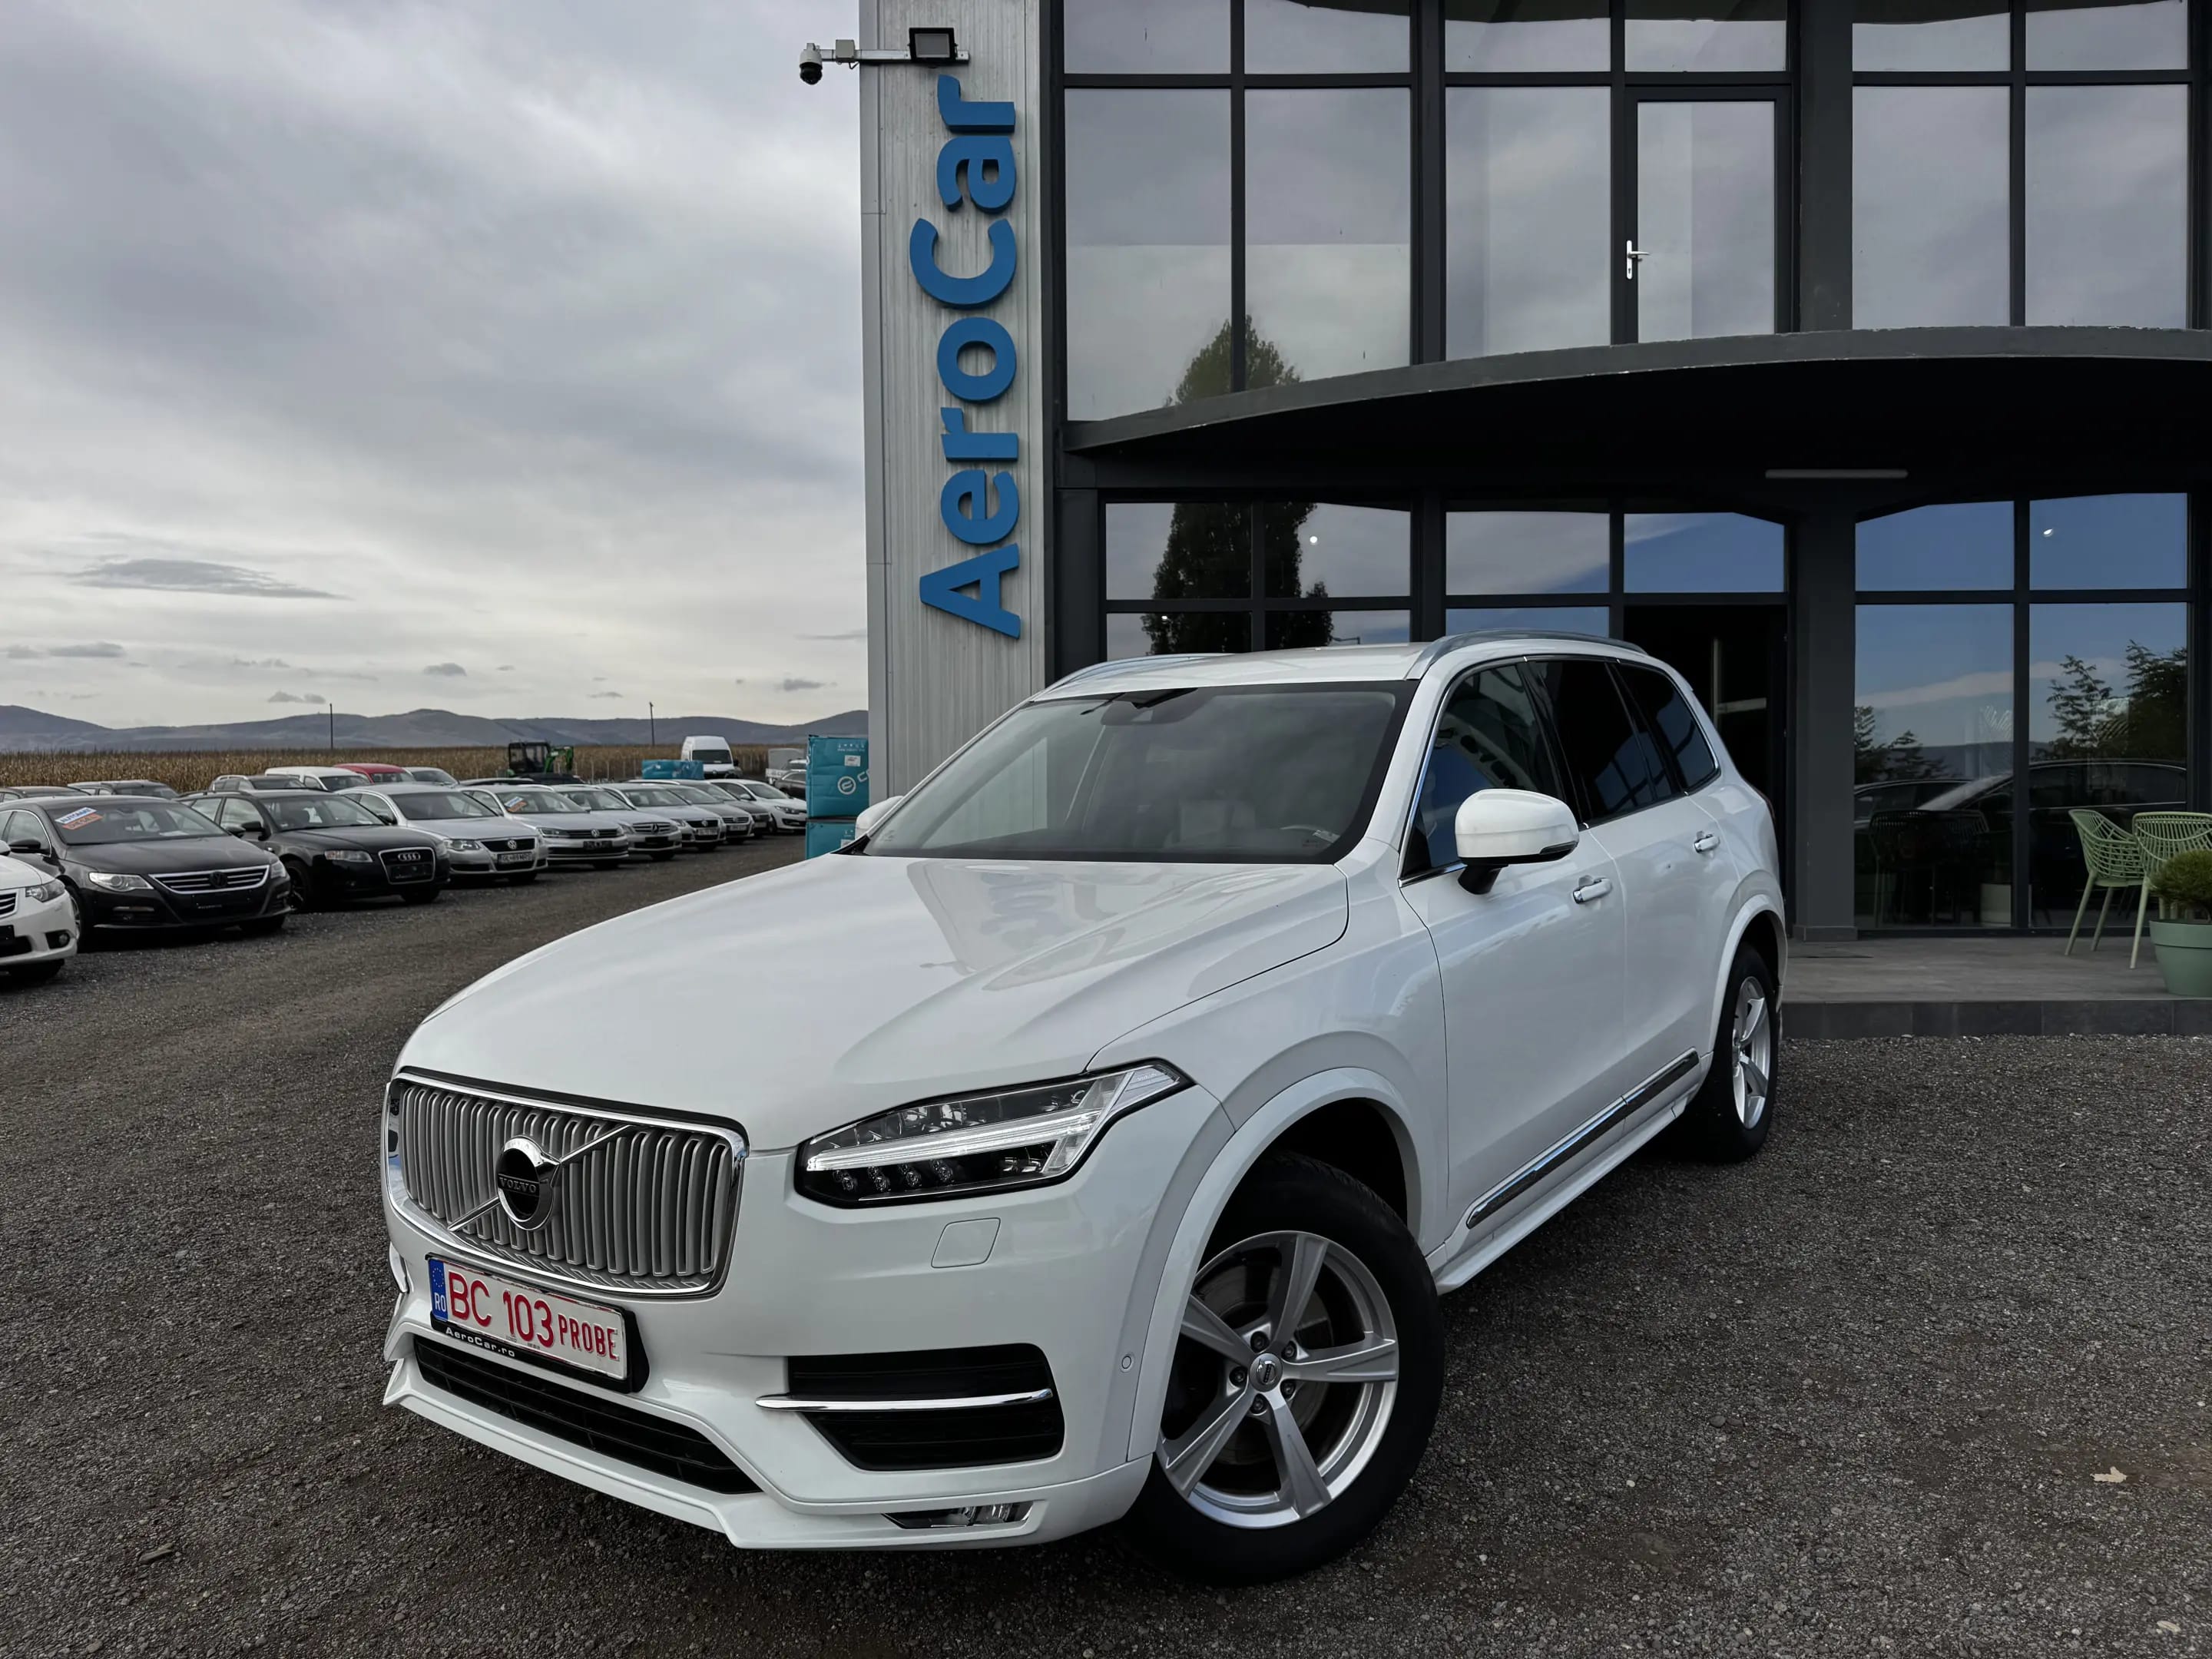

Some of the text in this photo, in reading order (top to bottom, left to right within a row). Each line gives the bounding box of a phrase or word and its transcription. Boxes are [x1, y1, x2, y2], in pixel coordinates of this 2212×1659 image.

[909, 75, 1021, 639] AeroCar
[498, 1177, 537, 1194] VOLVO
[434, 1292, 445, 1312] RO
[448, 1270, 620, 1362] BC 103 PROBE
[445, 1326, 515, 1357] AeroCar.ro
